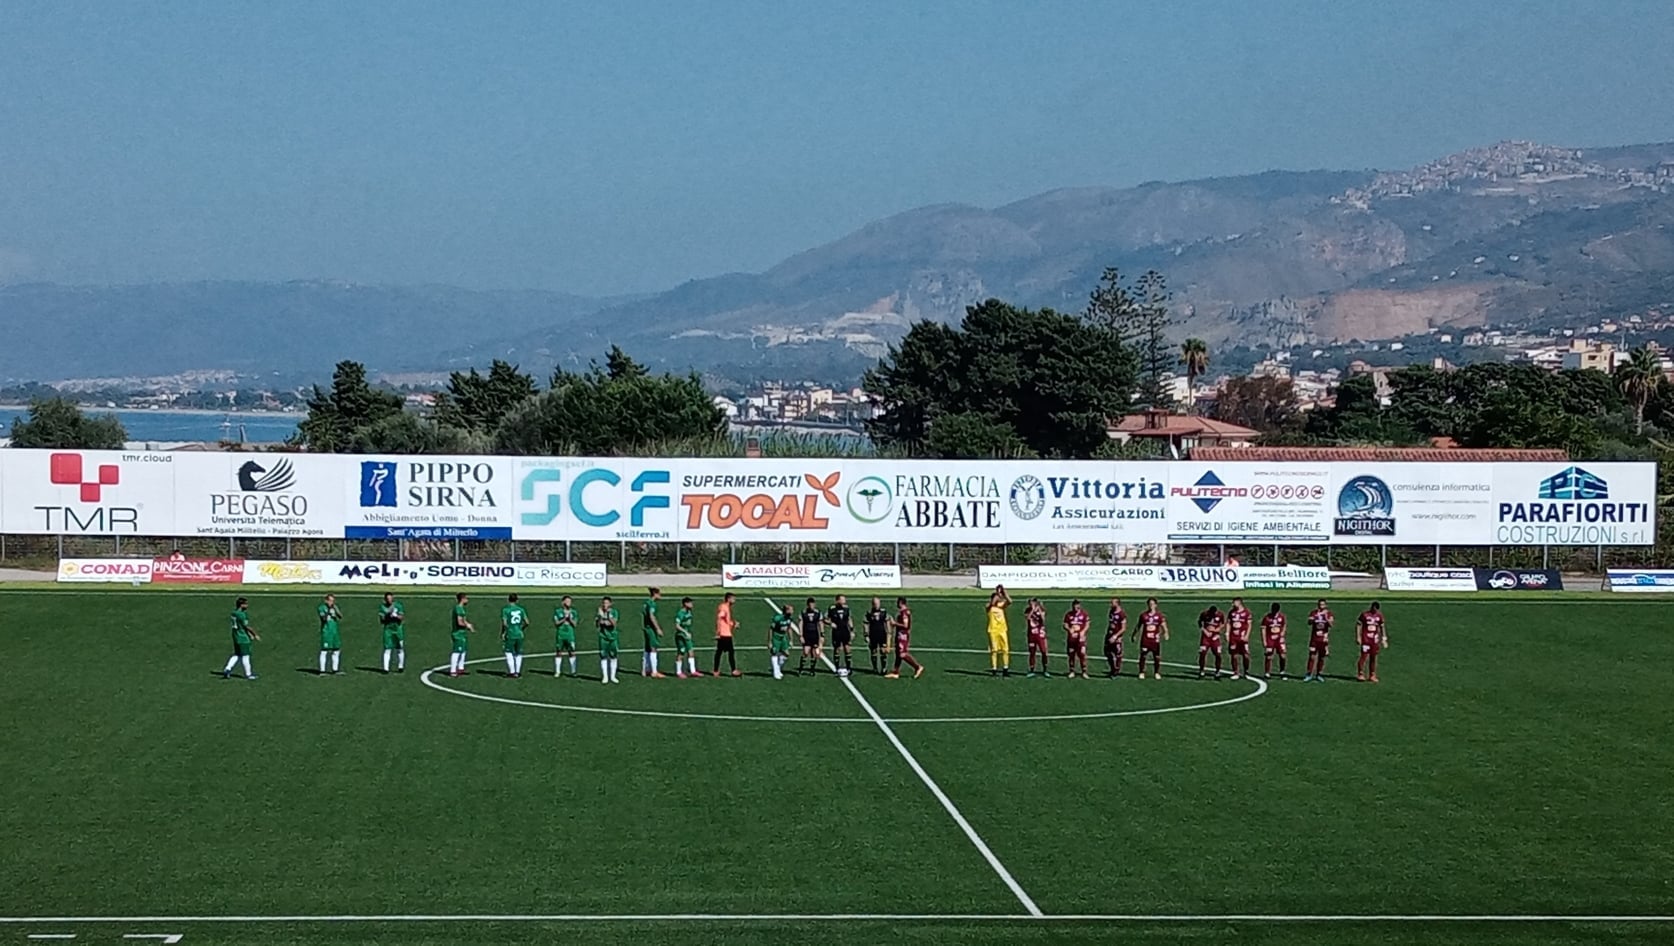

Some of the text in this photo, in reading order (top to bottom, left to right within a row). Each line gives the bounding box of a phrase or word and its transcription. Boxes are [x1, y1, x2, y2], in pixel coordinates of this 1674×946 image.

[122, 454, 172, 462] tmr.cloud
[409, 463, 494, 484] PIPPO
[682, 475, 801, 488] SUPERMERCATI
[895, 475, 1000, 498] FARMACIA
[1047, 477, 1165, 499] Vittoria
[1392, 483, 1490, 492] consulenza informatica
[408, 486, 497, 507] SIRNA
[521, 468, 670, 527] SCF
[210, 494, 308, 516] PEGASO
[34, 506, 138, 532] TMR
[362, 514, 429, 523] Abbigliamento
[432, 515, 458, 523] Uomo
[895, 500, 1001, 528] ABBATE
[1051, 506, 1165, 519] Assicurazioni
[1499, 503, 1648, 523] PARAFIORITI
[258, 516, 305, 525] Telematica
[1177, 521, 1321, 532] SERVIZI DI IGIENE AMBIENTALE
[1337, 519, 1393, 532] NIGITHOR
[433, 528, 442, 536] di
[616, 530, 670, 539] sicilferro.it
[1497, 526, 1647, 544] COSTRUZIONI s.r.l.
[81, 564, 150, 575] CONAD
[427, 566, 515, 578] SORBINO
[541, 569, 604, 580] Risacca
[743, 566, 810, 575] AMADORE
[1111, 568, 1153, 576] CARRO
[1177, 569, 1237, 582] BRUNO
[510, 611, 521, 624] 25
